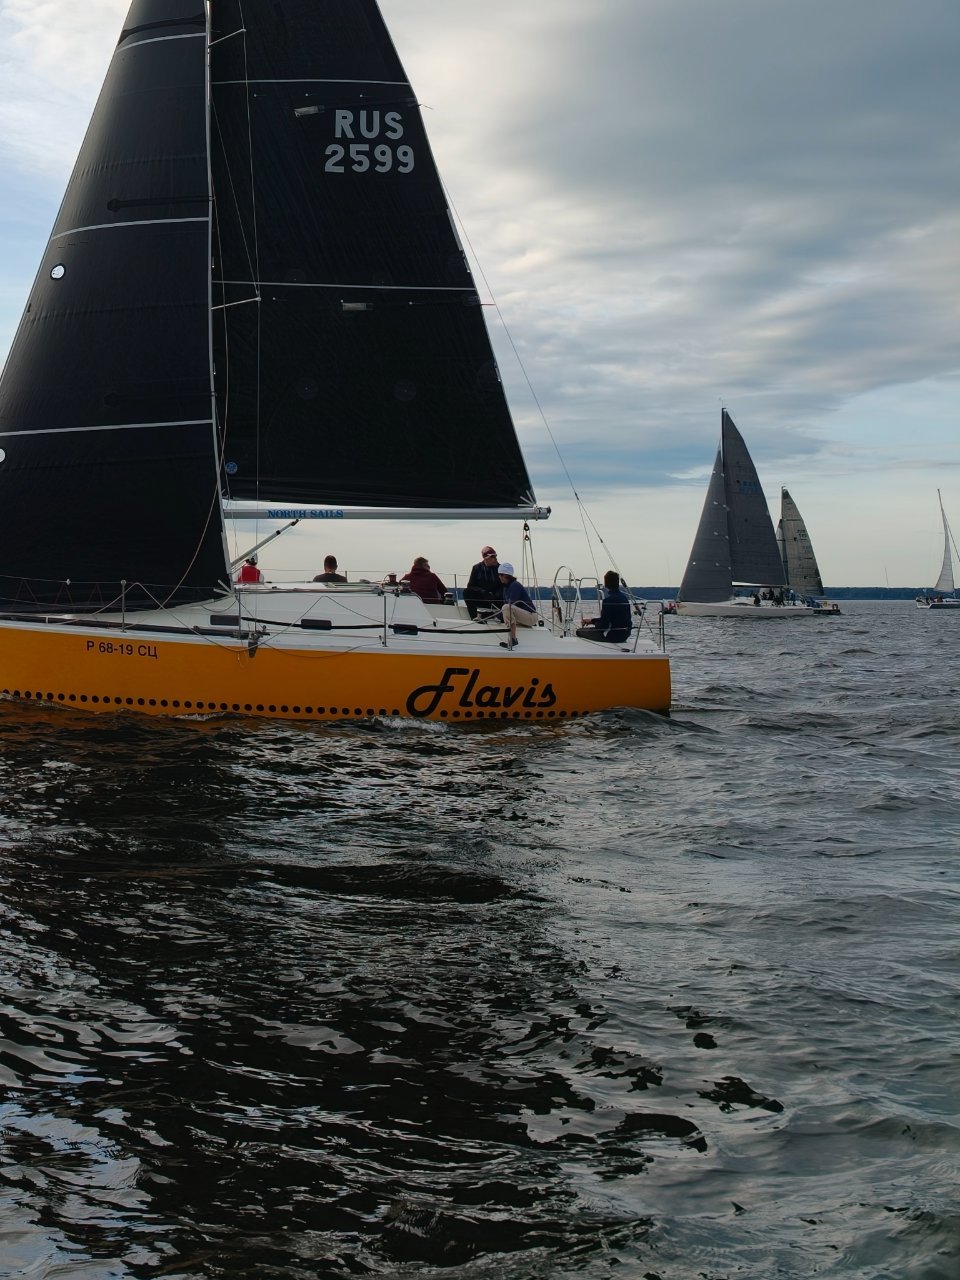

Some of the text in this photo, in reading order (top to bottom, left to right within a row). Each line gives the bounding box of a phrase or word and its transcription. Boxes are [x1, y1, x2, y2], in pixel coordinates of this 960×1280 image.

[335, 109, 404, 140] RUS
[324, 143, 415, 174] 2599
[267, 509, 344, 518] NORTH SAILS
[98, 642, 133, 656] 68-19
[406, 668, 557, 718] Flavis
